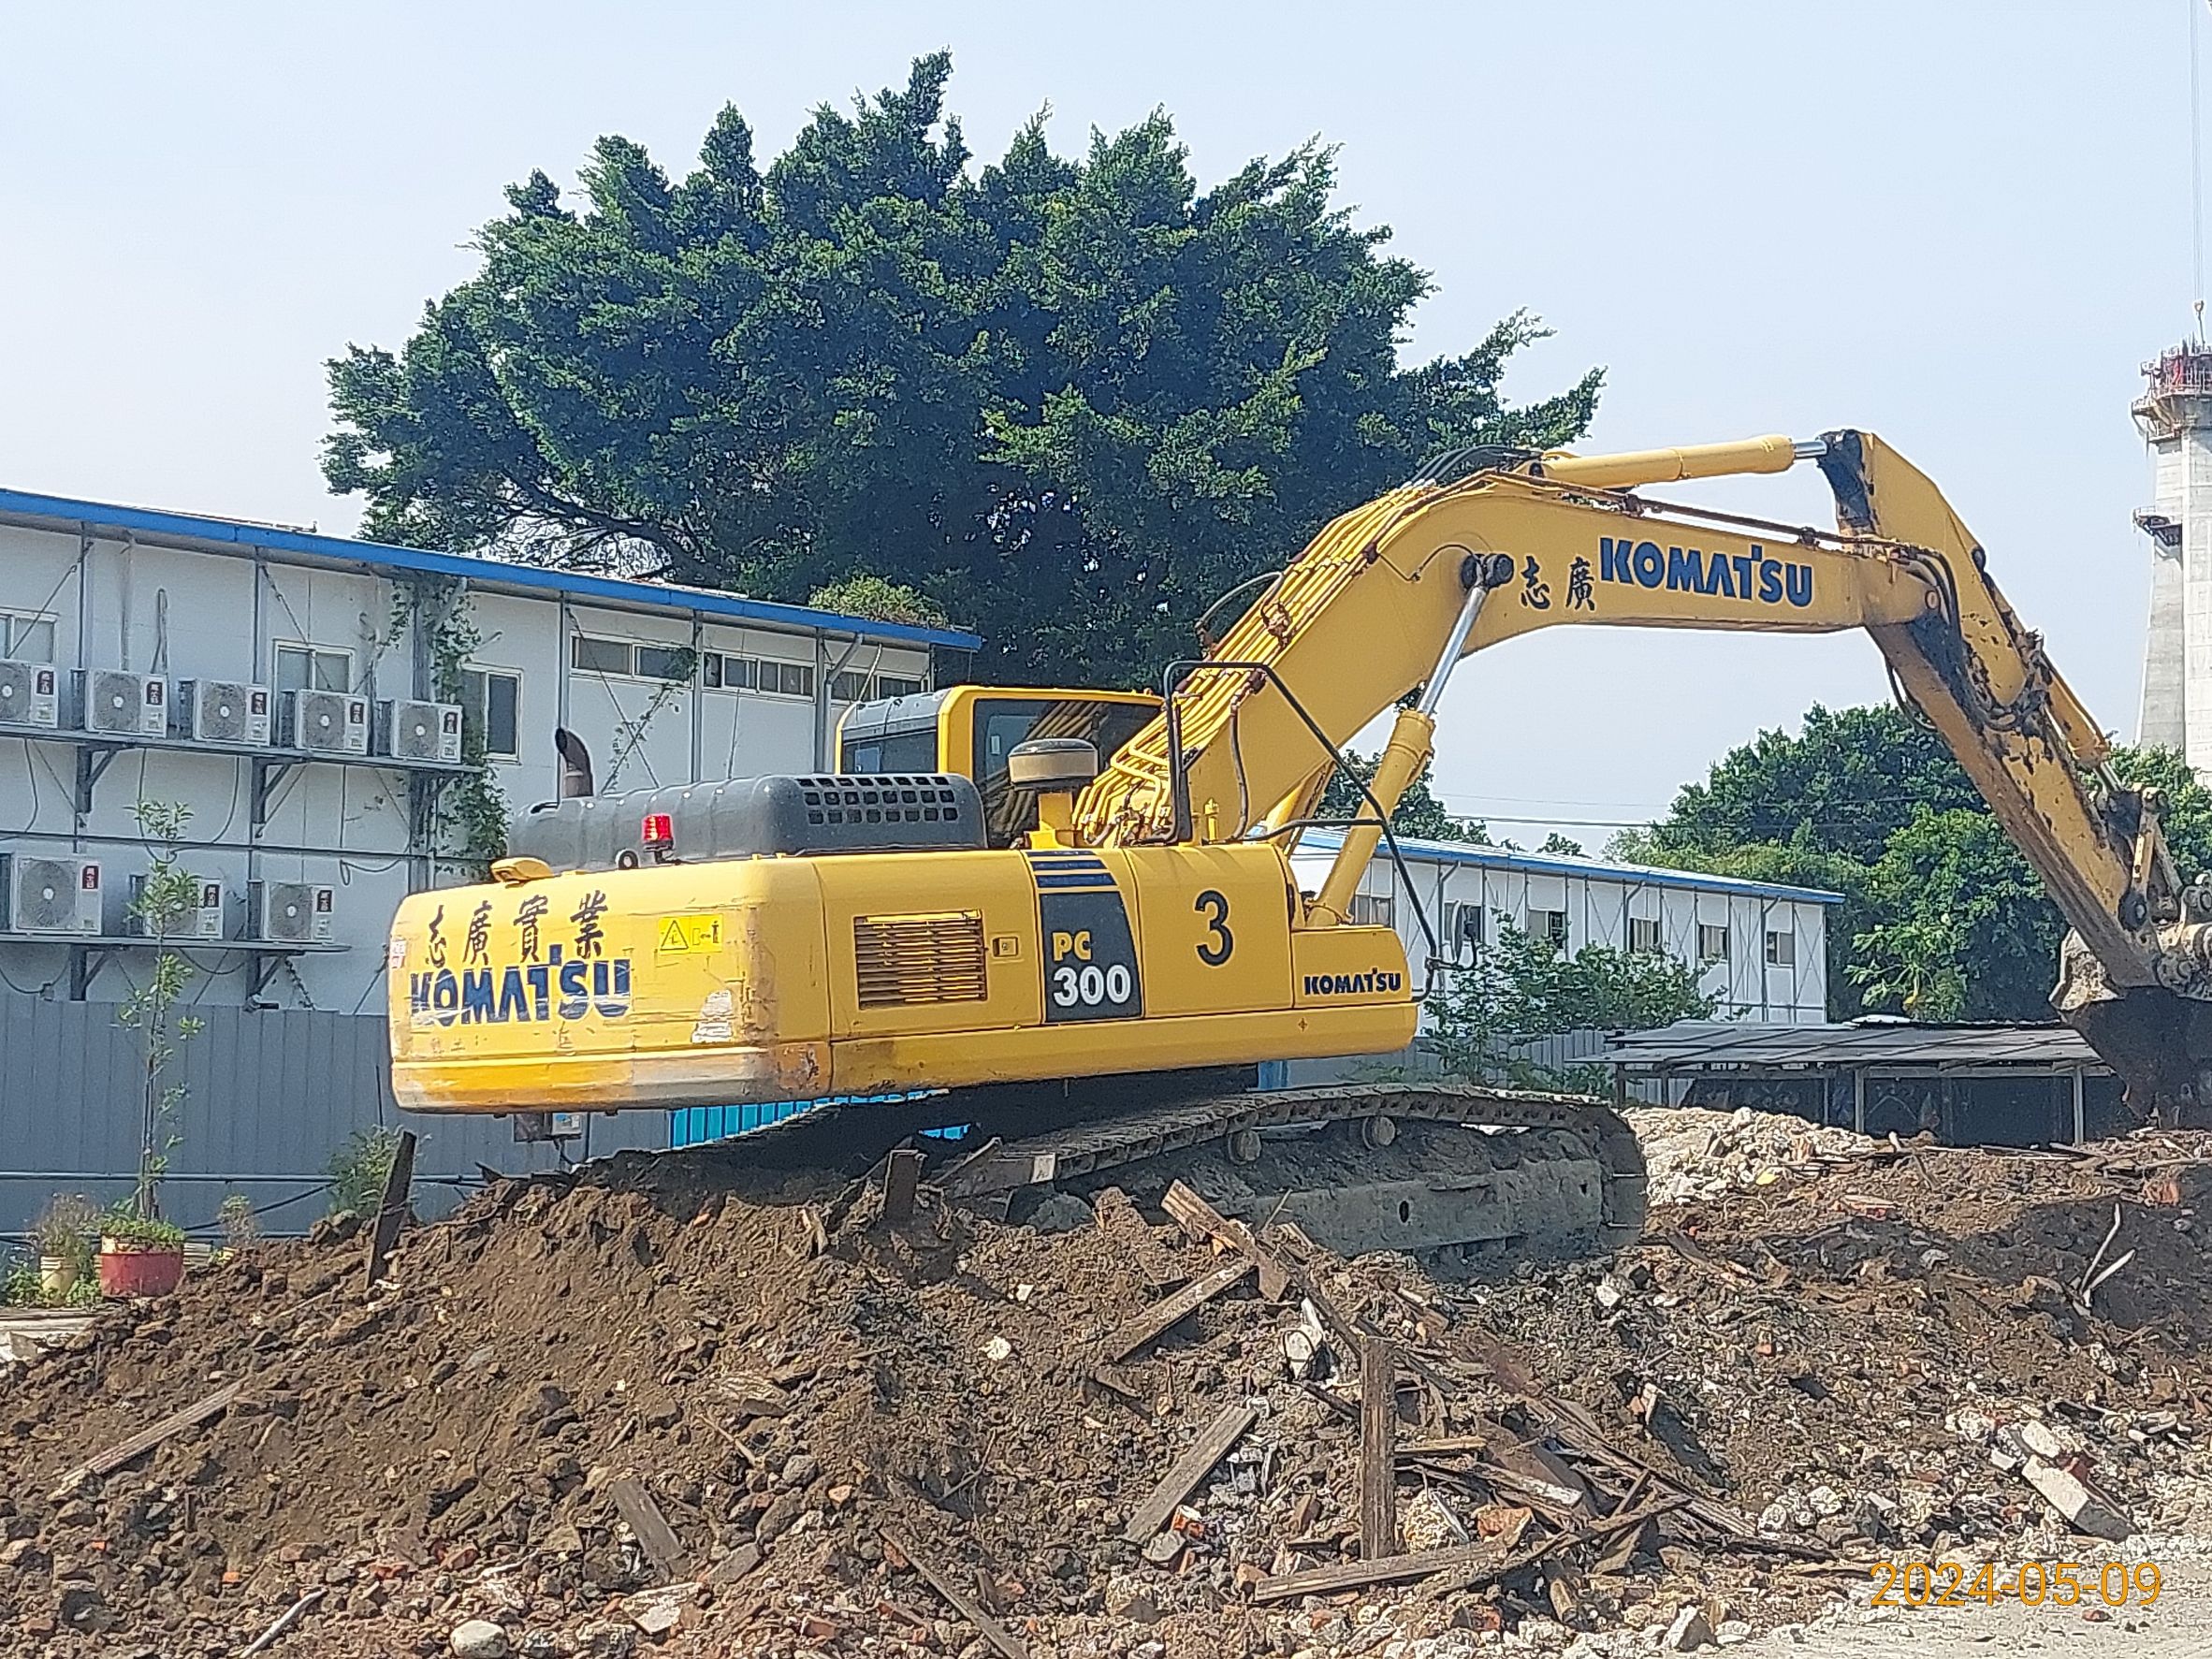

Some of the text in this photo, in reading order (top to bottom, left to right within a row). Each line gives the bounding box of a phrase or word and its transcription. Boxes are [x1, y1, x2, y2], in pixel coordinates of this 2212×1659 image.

[1521, 556, 1595, 611] 志廣
[1599, 536, 1812, 607] KOMATSU
[1052, 931, 1093, 962] PC
[1194, 890, 1234, 967] 3
[411, 944, 632, 1027] KOMATSU
[1052, 965, 1131, 1007] 300
[1304, 967, 1401, 996] KOMATSU
